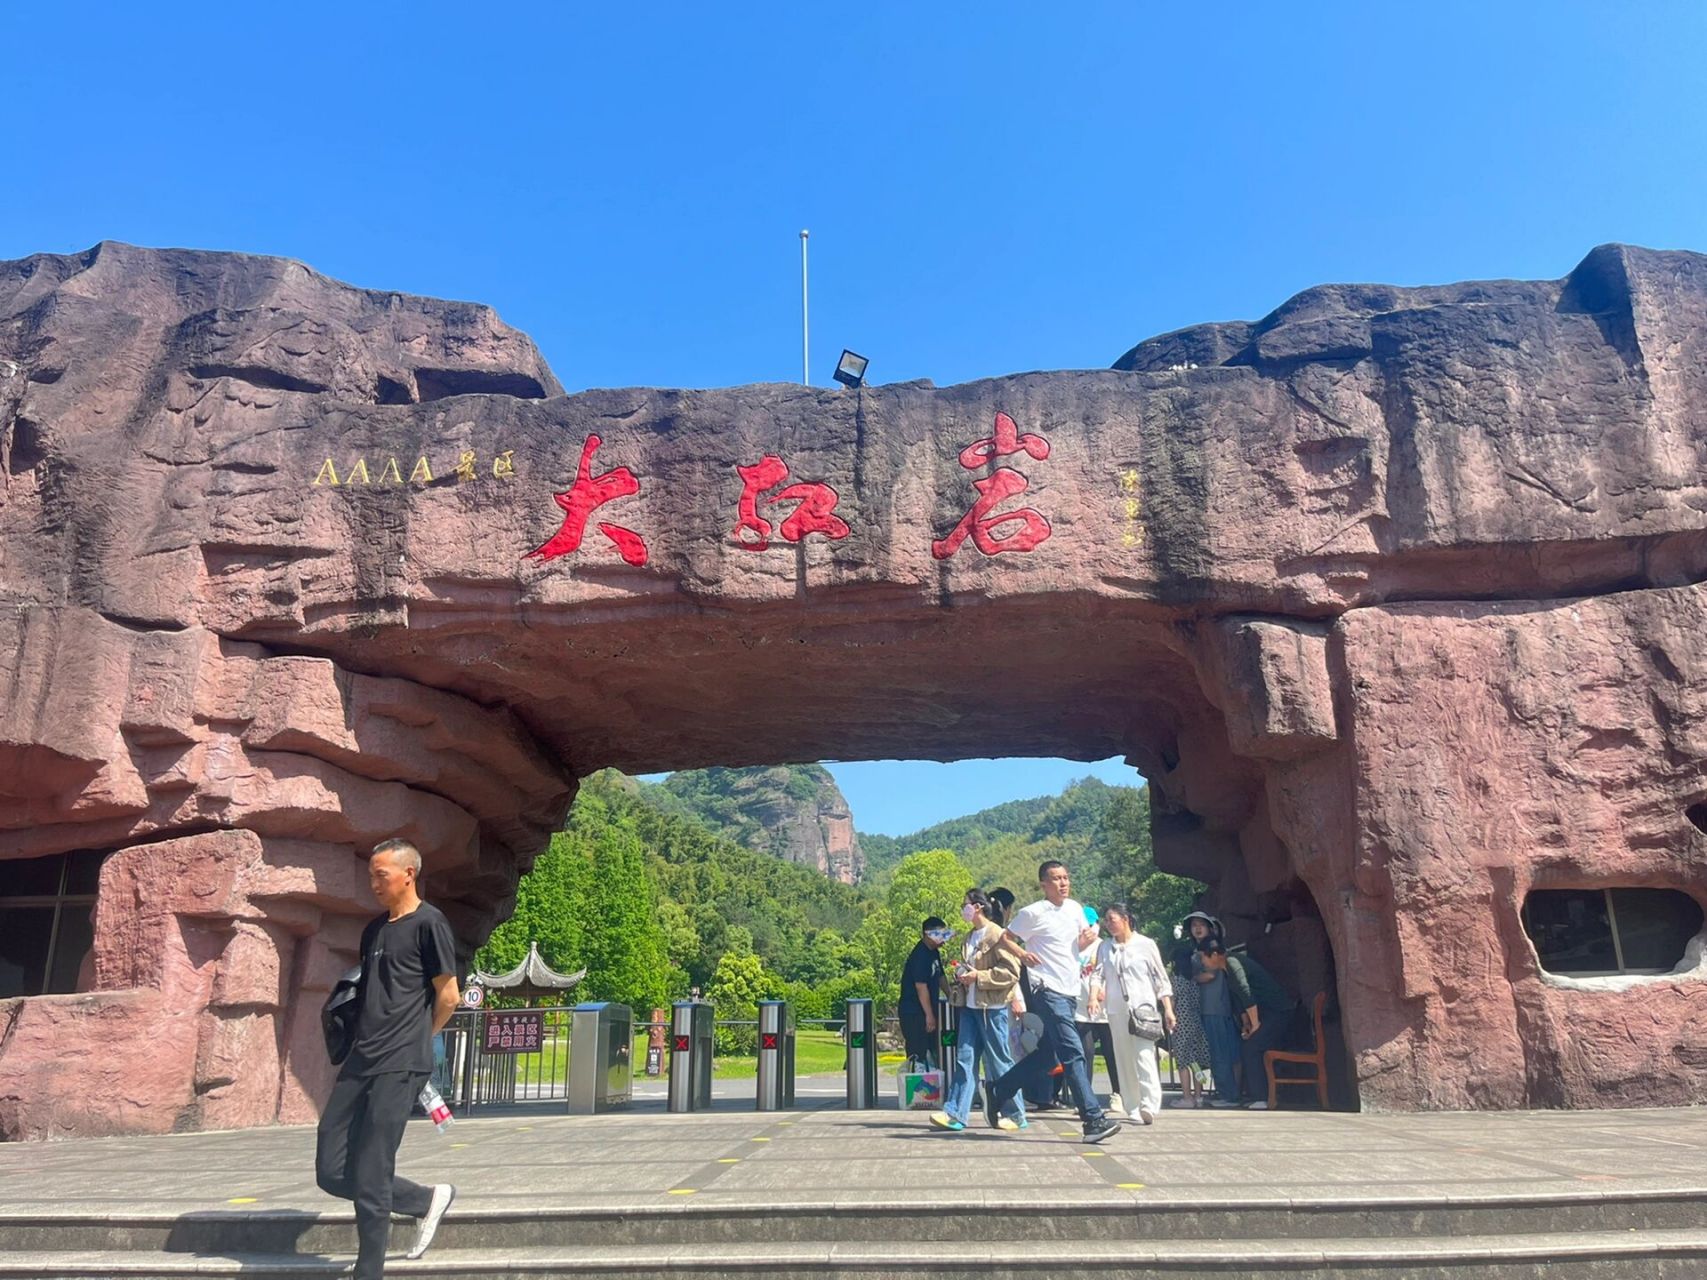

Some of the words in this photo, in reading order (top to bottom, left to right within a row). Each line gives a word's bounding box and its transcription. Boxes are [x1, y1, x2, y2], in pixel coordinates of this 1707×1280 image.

[313, 456, 434, 485] AAAA
[452, 448, 514, 481] 景区
[468, 991, 479, 1002] 10
[488, 1024, 538, 1036] 进入景区
[487, 1036, 537, 1048] 严禁用火
